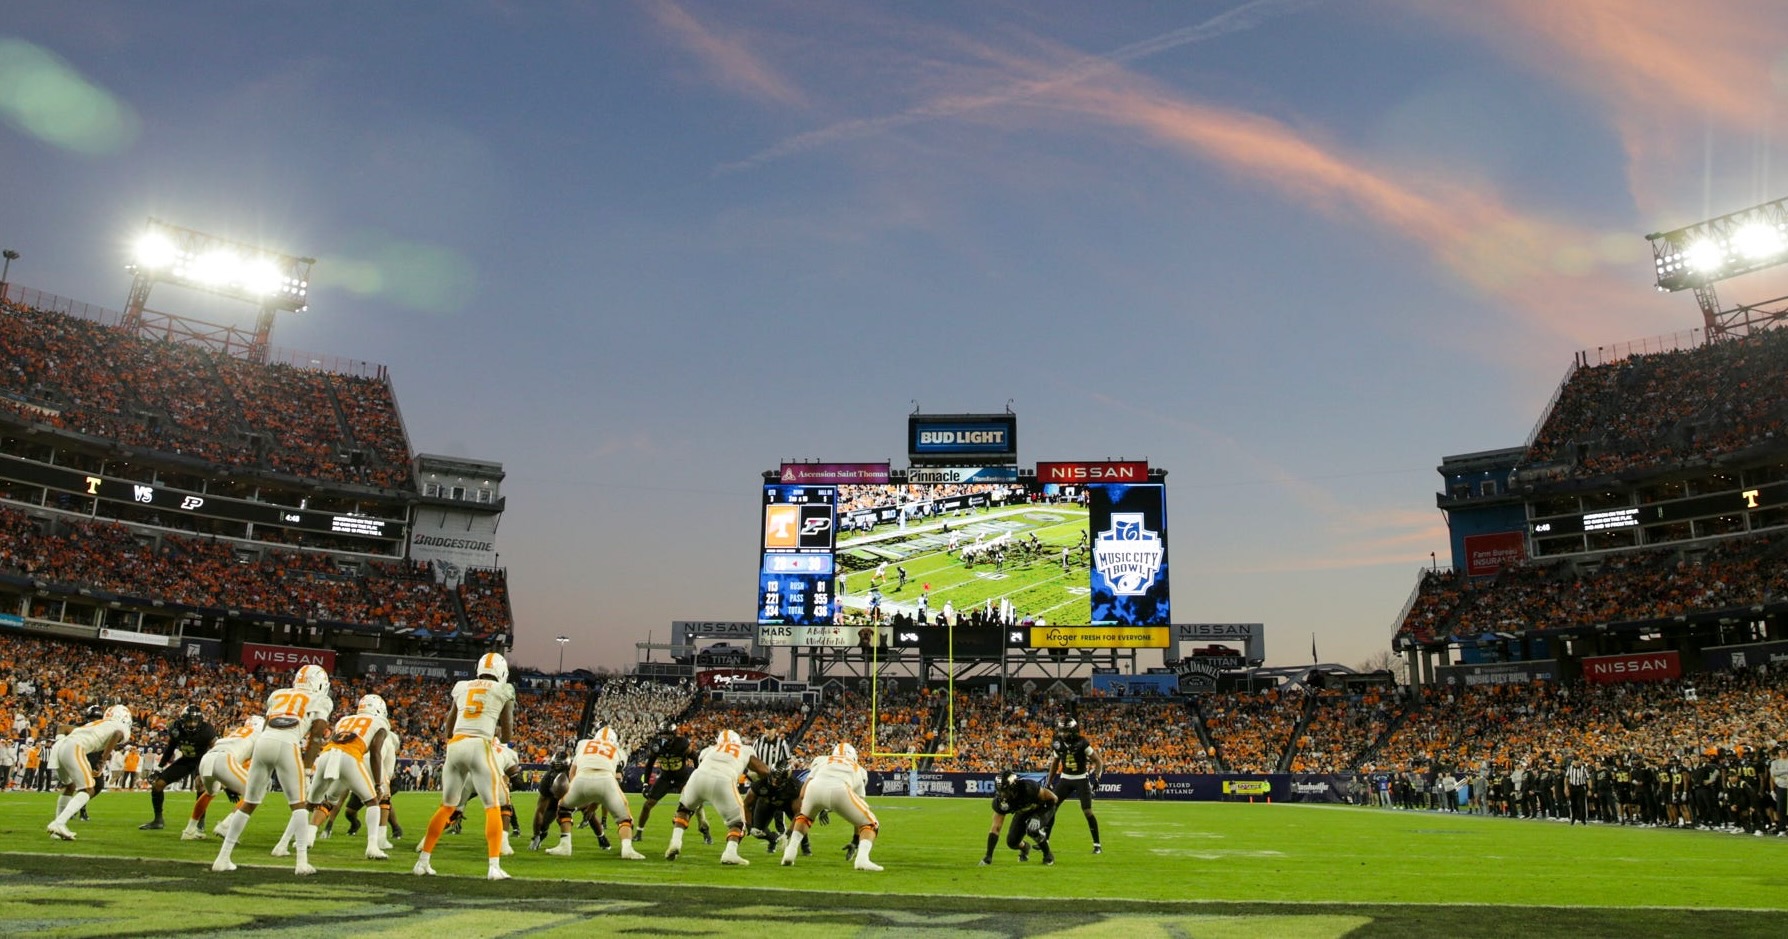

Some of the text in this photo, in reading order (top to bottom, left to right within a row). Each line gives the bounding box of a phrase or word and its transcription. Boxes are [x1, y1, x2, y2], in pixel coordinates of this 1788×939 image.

[920, 431, 1004, 444] BUD LIGHT
[798, 470, 888, 478] Ascension Saint Thomas
[910, 470, 960, 482] Pinnacle
[1052, 467, 1134, 478] NISSAN
[134, 484, 153, 503] VS
[414, 534, 492, 552] BRIDGESTONE
[1098, 552, 1158, 567] MUSIC CITY
[1113, 564, 1142, 574] BOWL
[766, 593, 828, 604] 221 PASS 355
[765, 605, 779, 616] 334
[788, 606, 804, 615] TOTAL
[685, 623, 752, 632] NISSAN
[762, 627, 792, 636] MARS
[1180, 625, 1250, 634] NISSAN
[1046, 629, 1077, 646] Kroger
[254, 650, 324, 665] NISSAN
[711, 656, 741, 664] TITAN
[1207, 658, 1237, 666] TITAN
[1594, 658, 1667, 674] NISSAN
[463, 688, 487, 718] 5
[583, 741, 616, 759] 63
